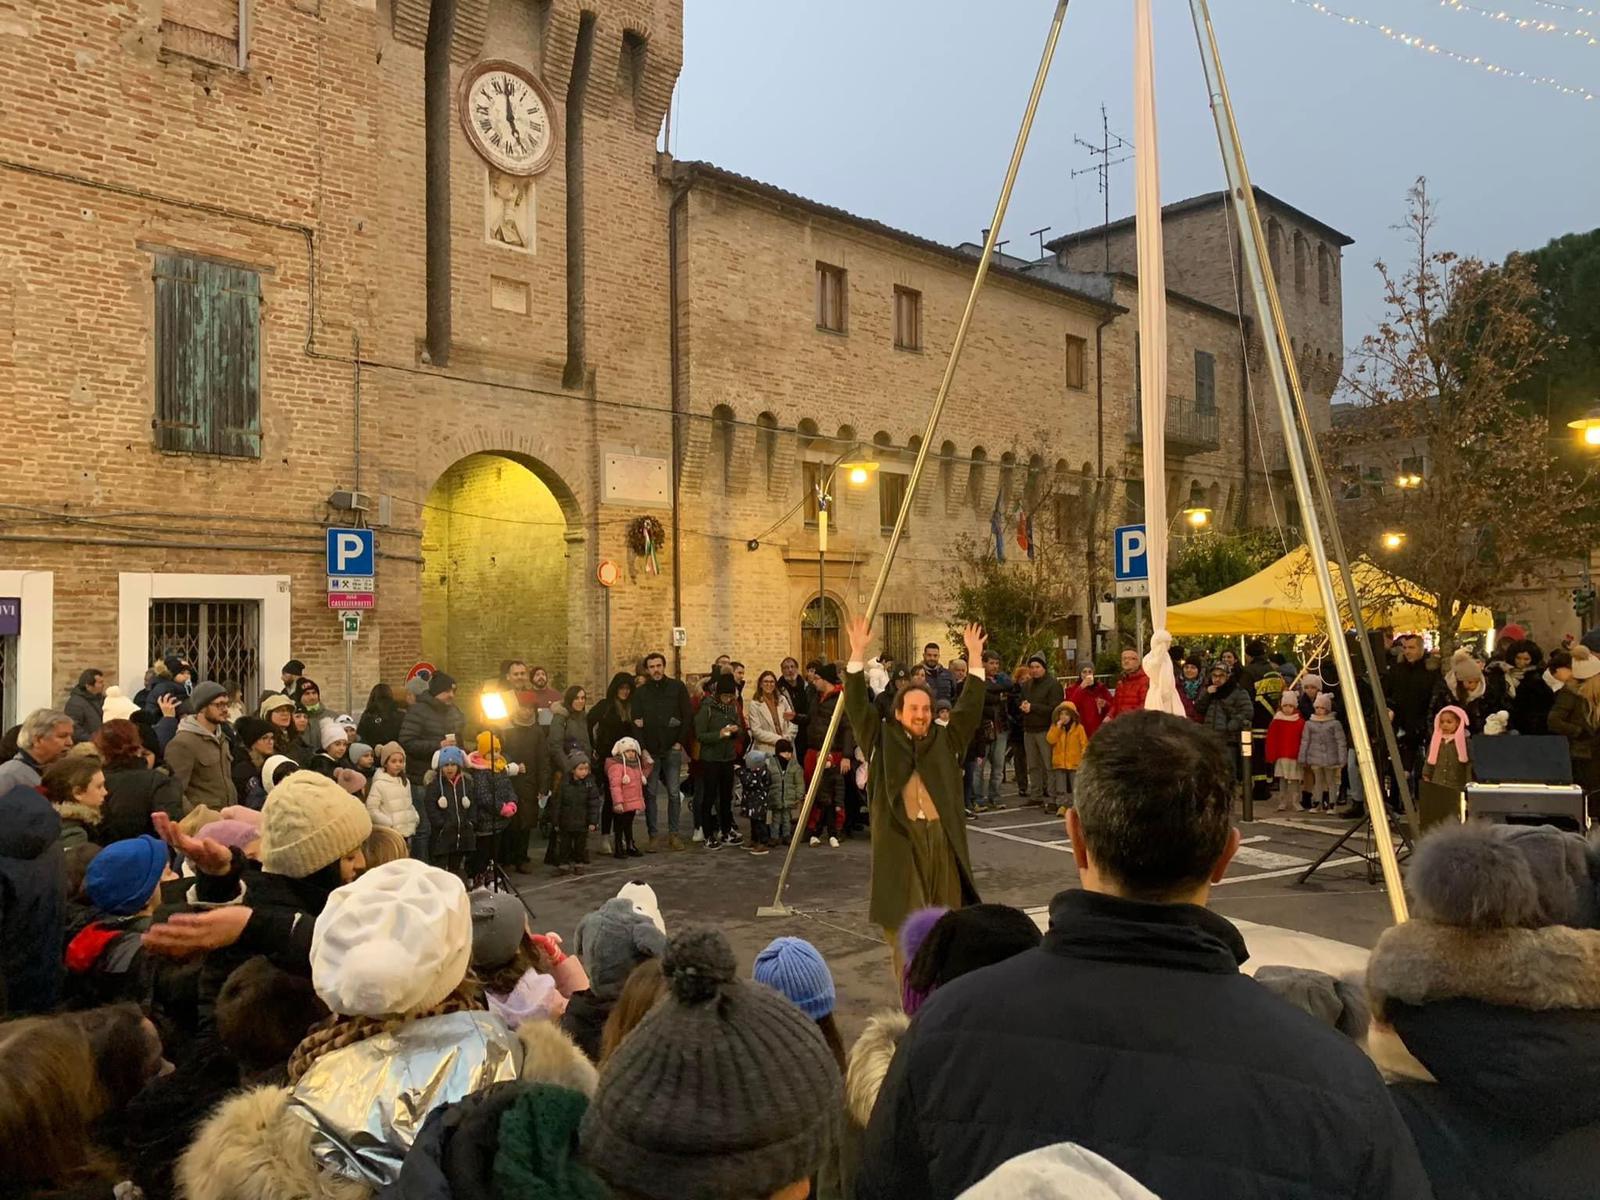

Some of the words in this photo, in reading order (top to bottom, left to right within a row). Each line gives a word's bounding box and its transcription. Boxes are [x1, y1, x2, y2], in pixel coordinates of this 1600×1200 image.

[337, 533, 364, 571] P
[1122, 530, 1146, 573] P
[0, 604, 15, 616] VI
